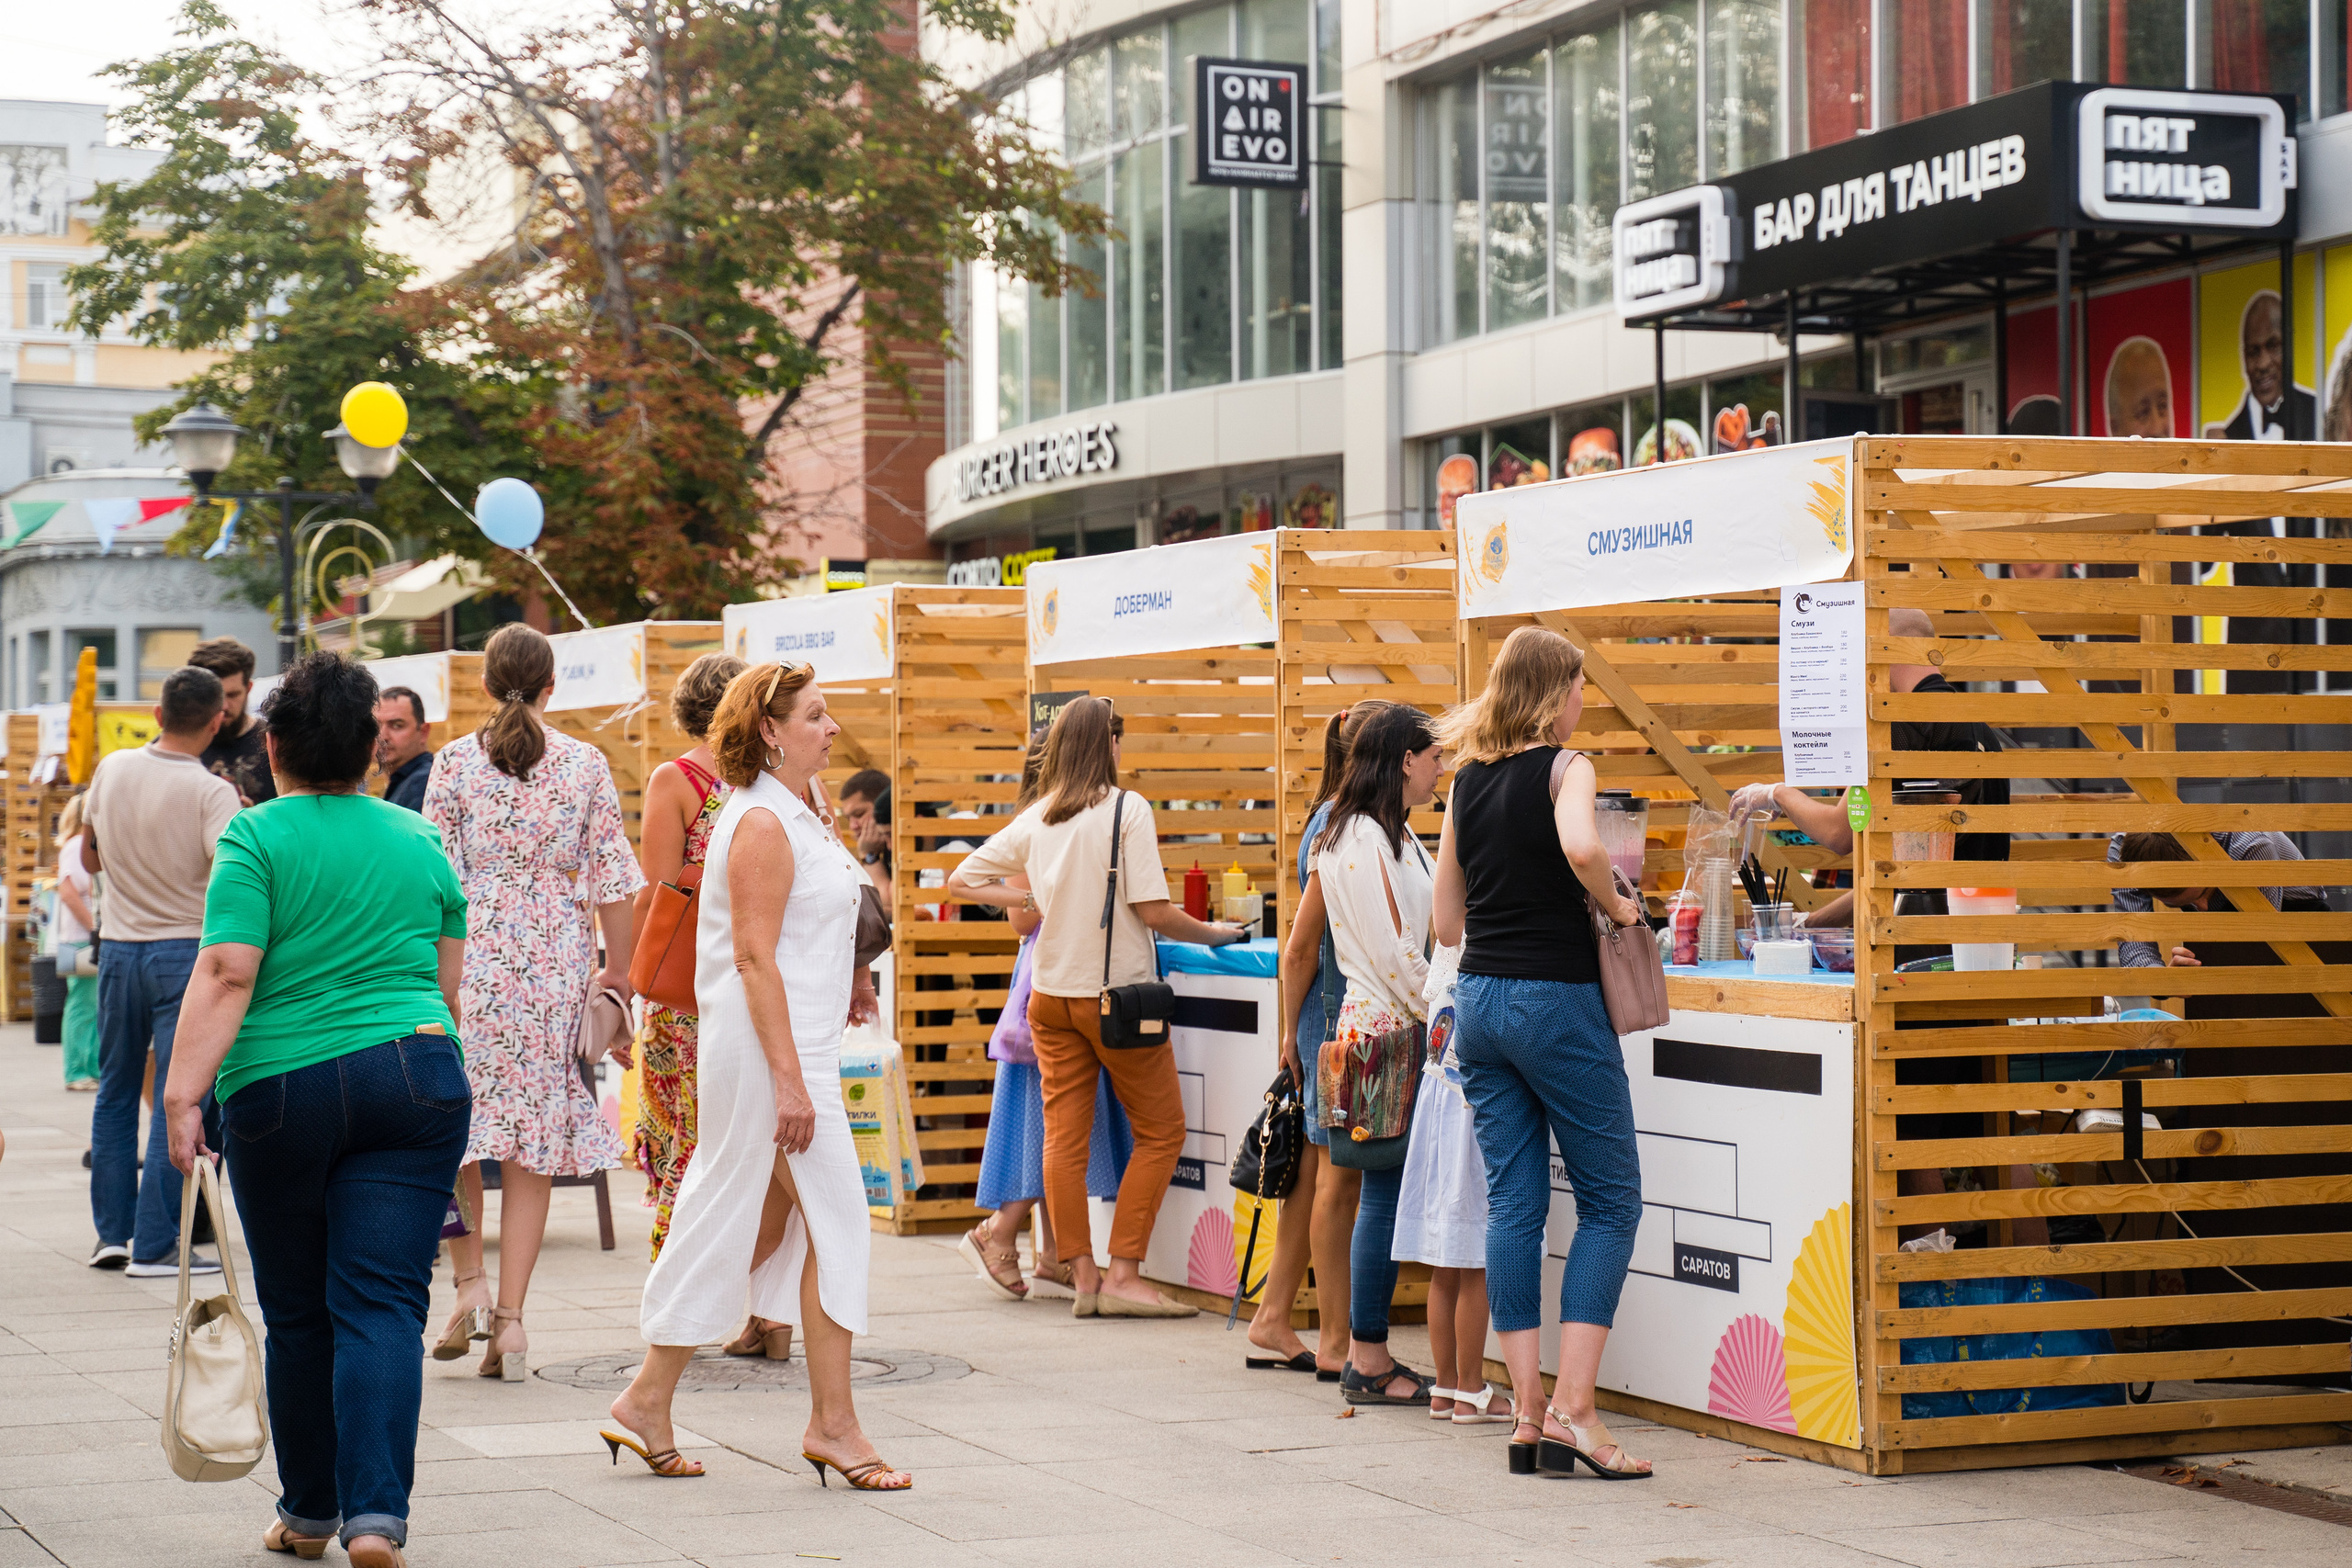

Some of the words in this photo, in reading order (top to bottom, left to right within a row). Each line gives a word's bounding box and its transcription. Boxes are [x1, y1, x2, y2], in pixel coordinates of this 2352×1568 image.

[1222, 75, 1270, 102] ON
[1222, 105, 1283, 132] AIR
[1222, 134, 1287, 162] EVO
[1754, 192, 1815, 251] БАР
[1817, 171, 1885, 242] ДЛЯ
[1890, 134, 2027, 213] ТАНЦЕВ
[1018, 420, 1115, 483] HEROES
[1588, 519, 1692, 556] СМУЗИШНАЯ
[1114, 590, 1172, 618] ДОБЕРМАН
[1815, 600, 1855, 609] Смузишная
[1791, 620, 1815, 628] Смузи
[1793, 740, 1828, 749] коктейли
[1173, 1165, 1200, 1181] АРАТОВ
[1681, 1255, 1731, 1280] САРАТОВ
